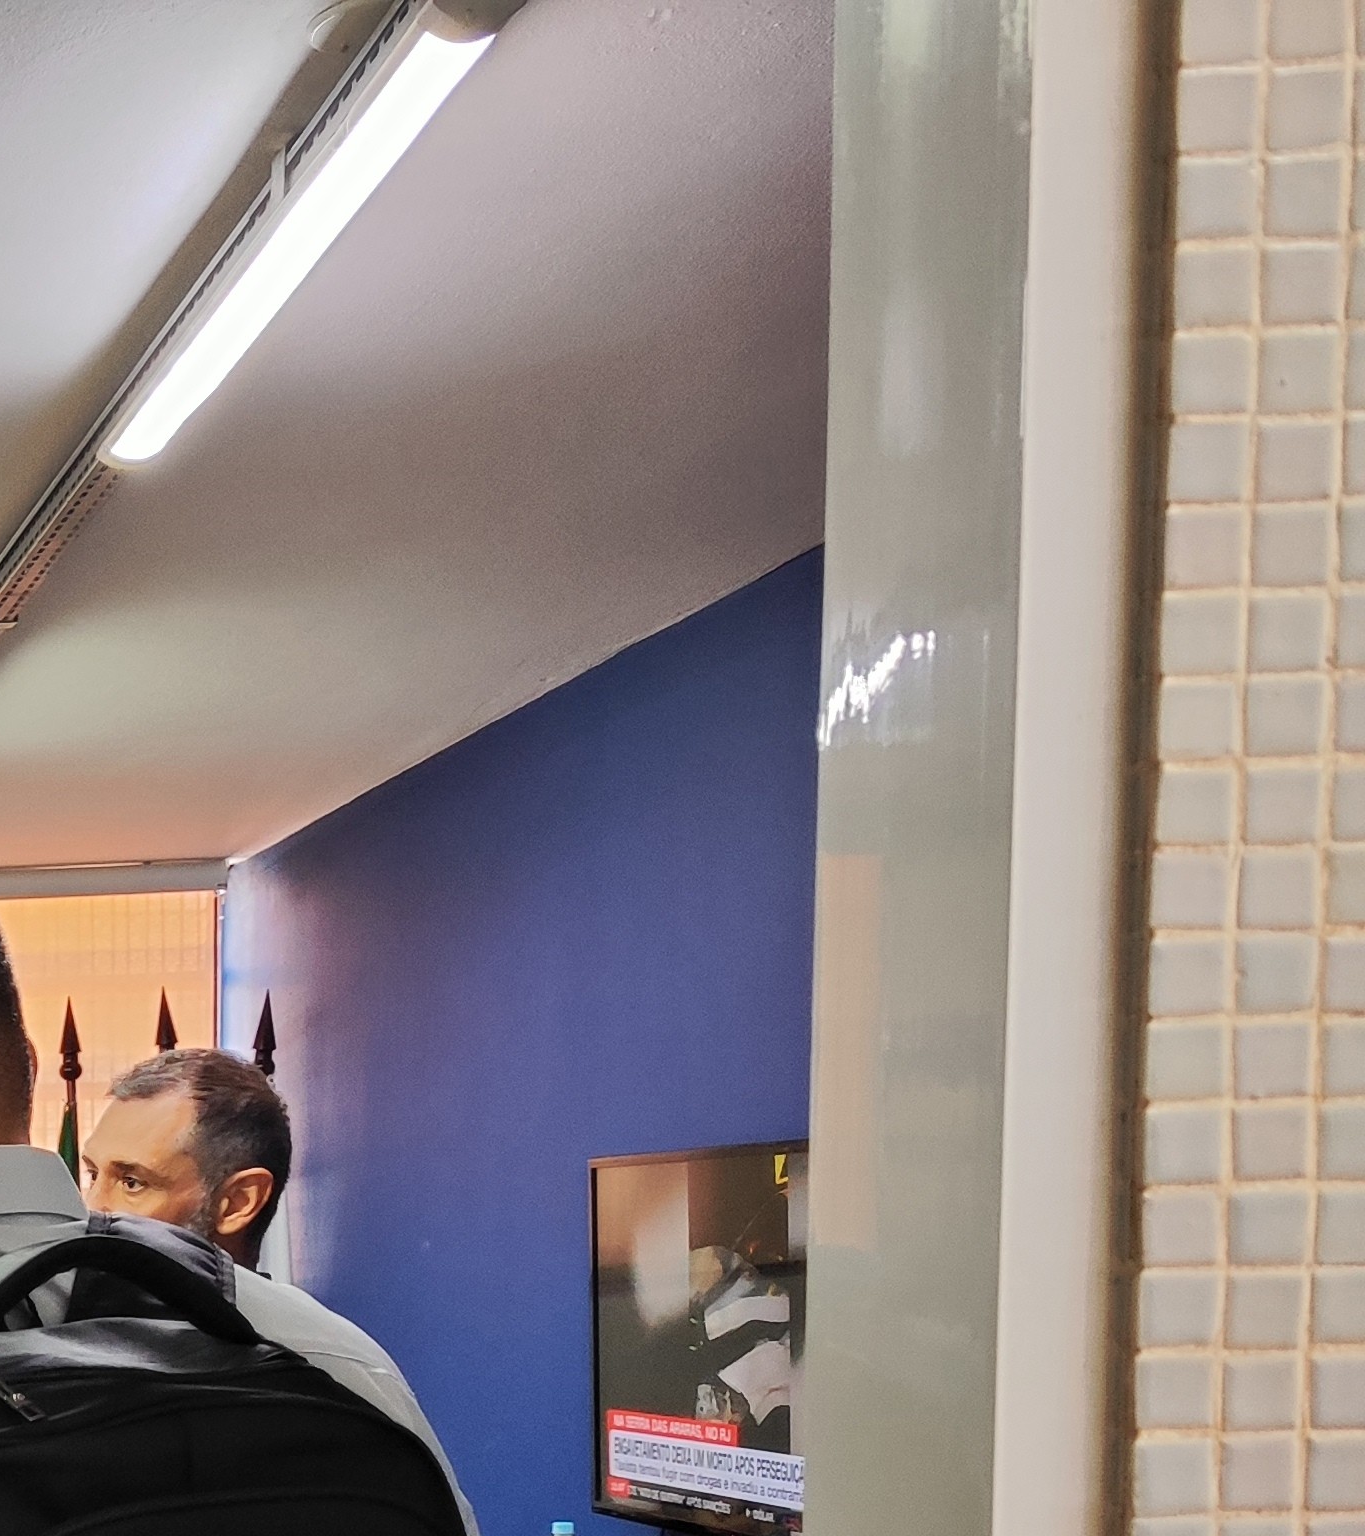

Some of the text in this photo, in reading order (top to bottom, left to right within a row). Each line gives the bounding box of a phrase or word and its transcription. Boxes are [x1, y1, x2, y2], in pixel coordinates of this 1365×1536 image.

[651, 1418, 668, 1434] DAS
[705, 1426, 718, 1440] NO
[719, 1427, 731, 1443] RJ
[614, 1436, 669, 1463] ENGAVETAMENTO
[671, 1445, 692, 1466] DEIXA
[693, 1447, 704, 1468] UM
[706, 1450, 733, 1473] MORTO
[756, 1457, 804, 1489] PERSEGUIÇÃ
[662, 1466, 678, 1483] fugir
[679, 1471, 695, 1484] com
[696, 1472, 722, 1490] drogas
[730, 1480, 758, 1495] invadiu
[759, 1485, 765, 1497] a
[767, 1486, 804, 1503] contram
